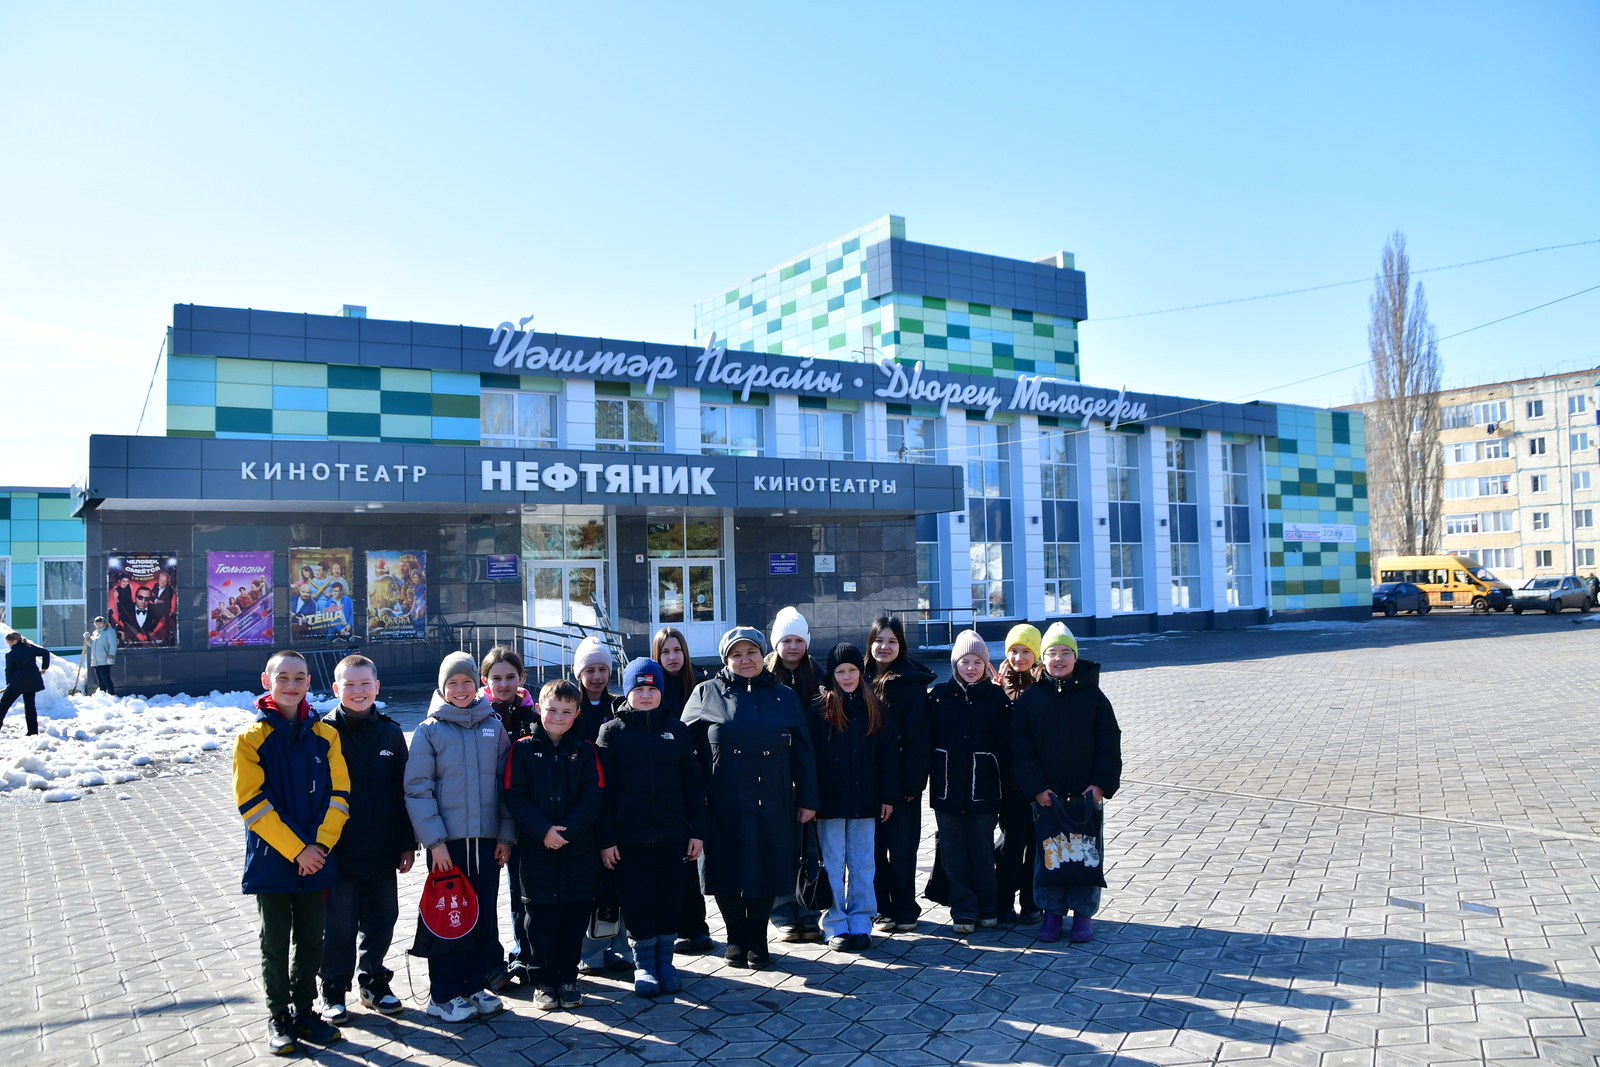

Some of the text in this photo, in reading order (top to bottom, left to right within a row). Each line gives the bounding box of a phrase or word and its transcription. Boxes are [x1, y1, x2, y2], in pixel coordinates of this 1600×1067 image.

[489, 314, 677, 396] Йәштәр
[874, 357, 1002, 421] Дворец
[1007, 374, 1148, 431] Молодежи
[241, 461, 427, 483] КИНОТЕАТР
[481, 460, 717, 496] НЕФТЯНИК
[753, 475, 897, 494] КИНОТЕАТРЫ
[306, 610, 344, 625] ТЁЩА
